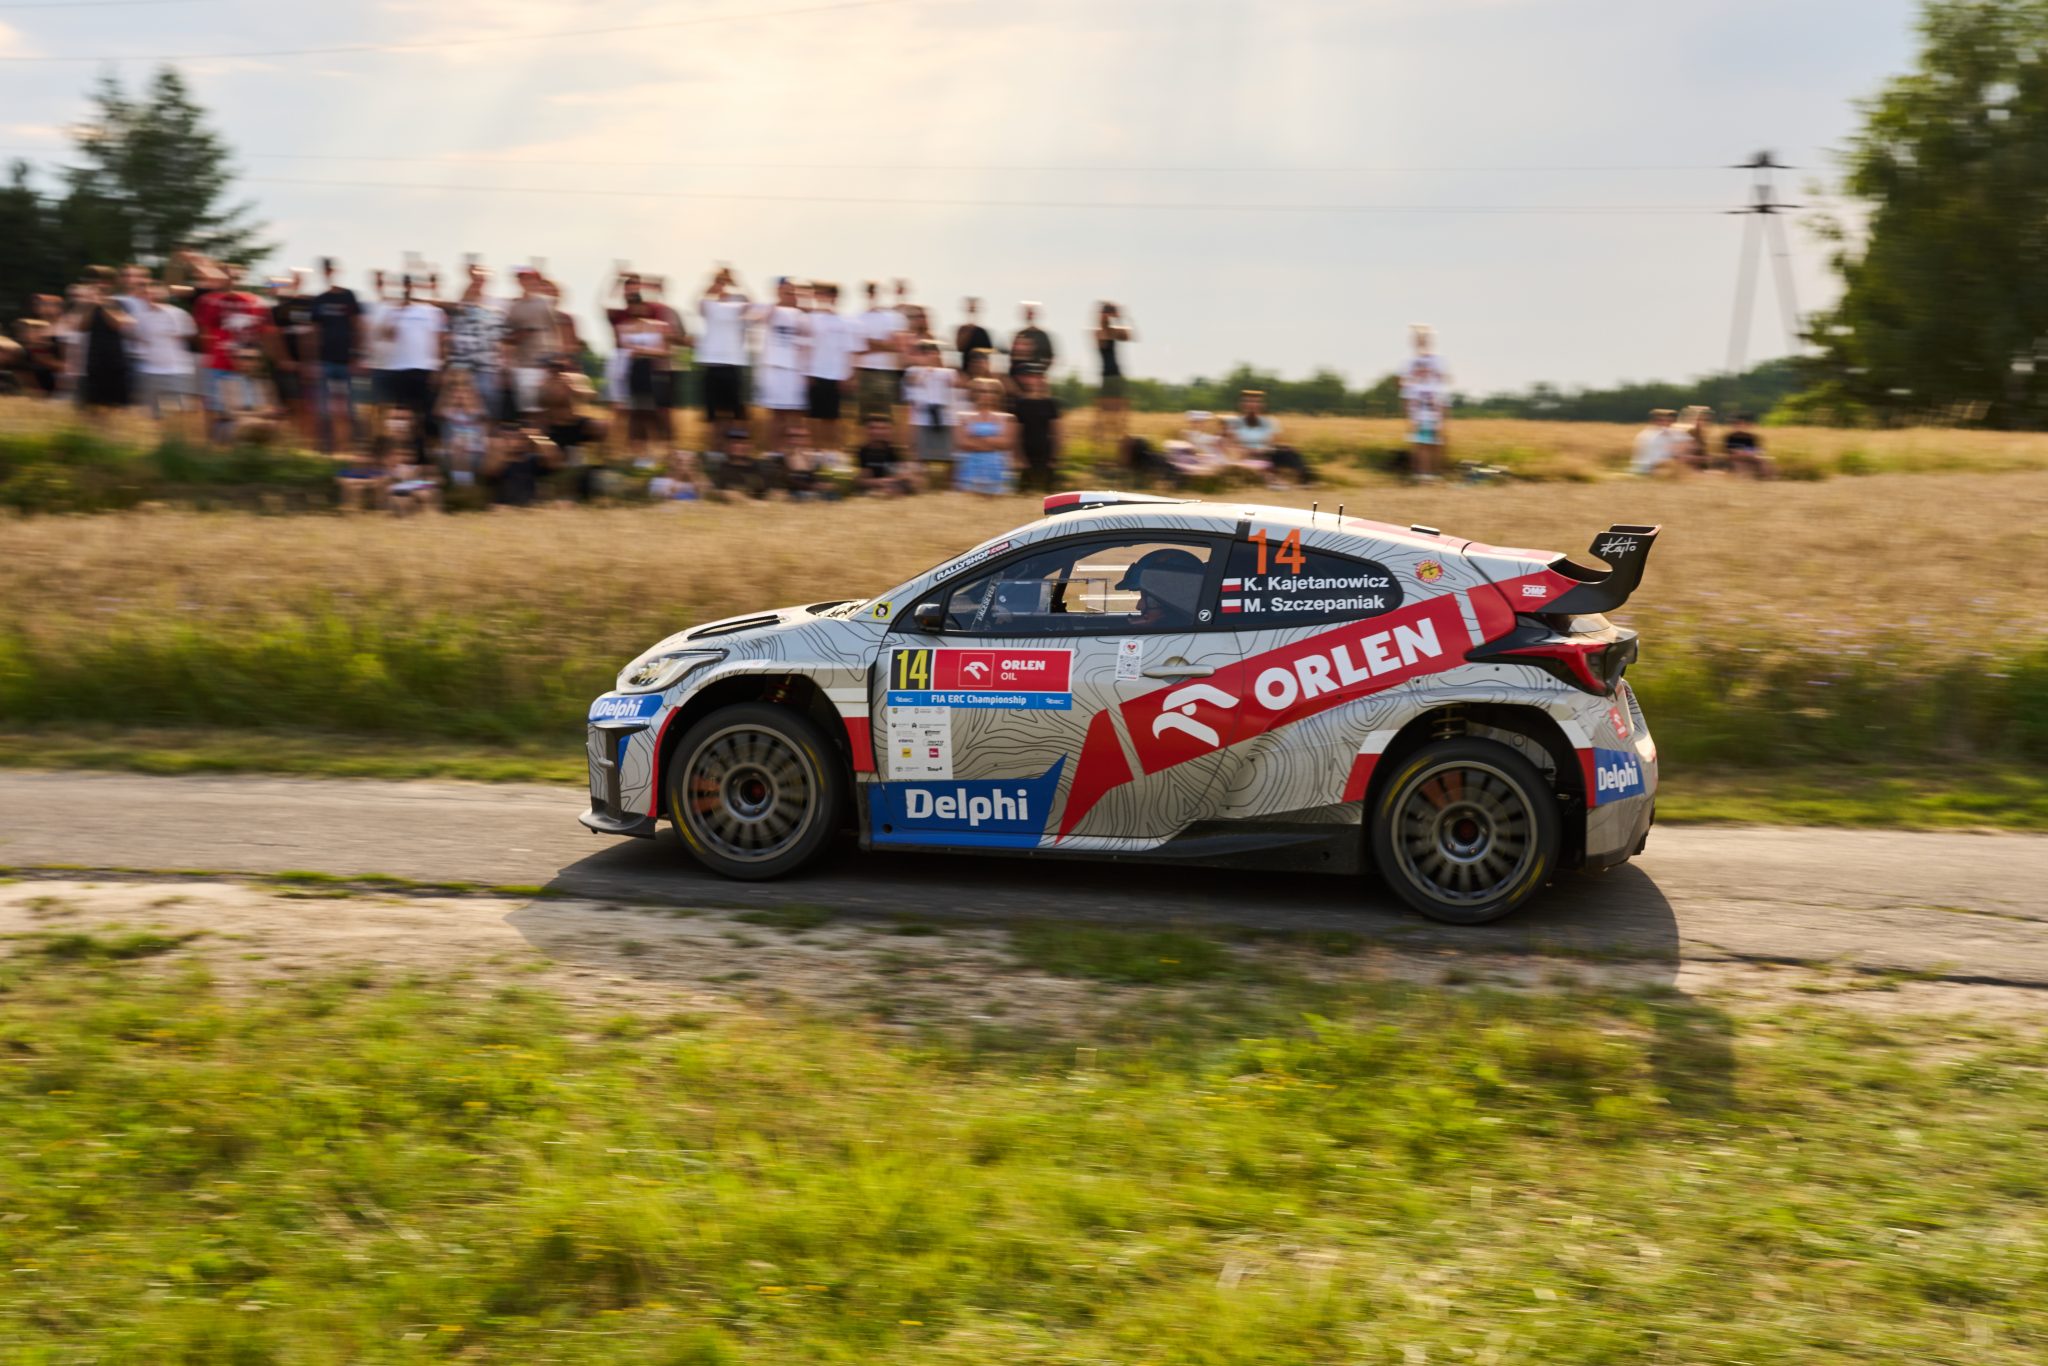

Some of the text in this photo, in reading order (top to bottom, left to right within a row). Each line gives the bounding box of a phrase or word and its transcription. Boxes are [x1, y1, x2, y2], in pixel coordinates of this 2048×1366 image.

[1247, 528, 1306, 575] 14
[1244, 574, 1389, 593] K. Kajetanowicz
[1522, 586, 1546, 596] OMP
[1244, 595, 1385, 613] M. Szczepaniak
[897, 649, 928, 690] 14
[1001, 659, 1046, 671] ORLEN
[1255, 617, 1443, 710] ORLEN
[1001, 672, 1018, 681] OIL
[597, 700, 643, 719] Delphi
[931, 694, 1027, 706] FIA ERC Championship
[1597, 761, 1639, 792] Delphi
[905, 788, 1028, 826] Delphi
